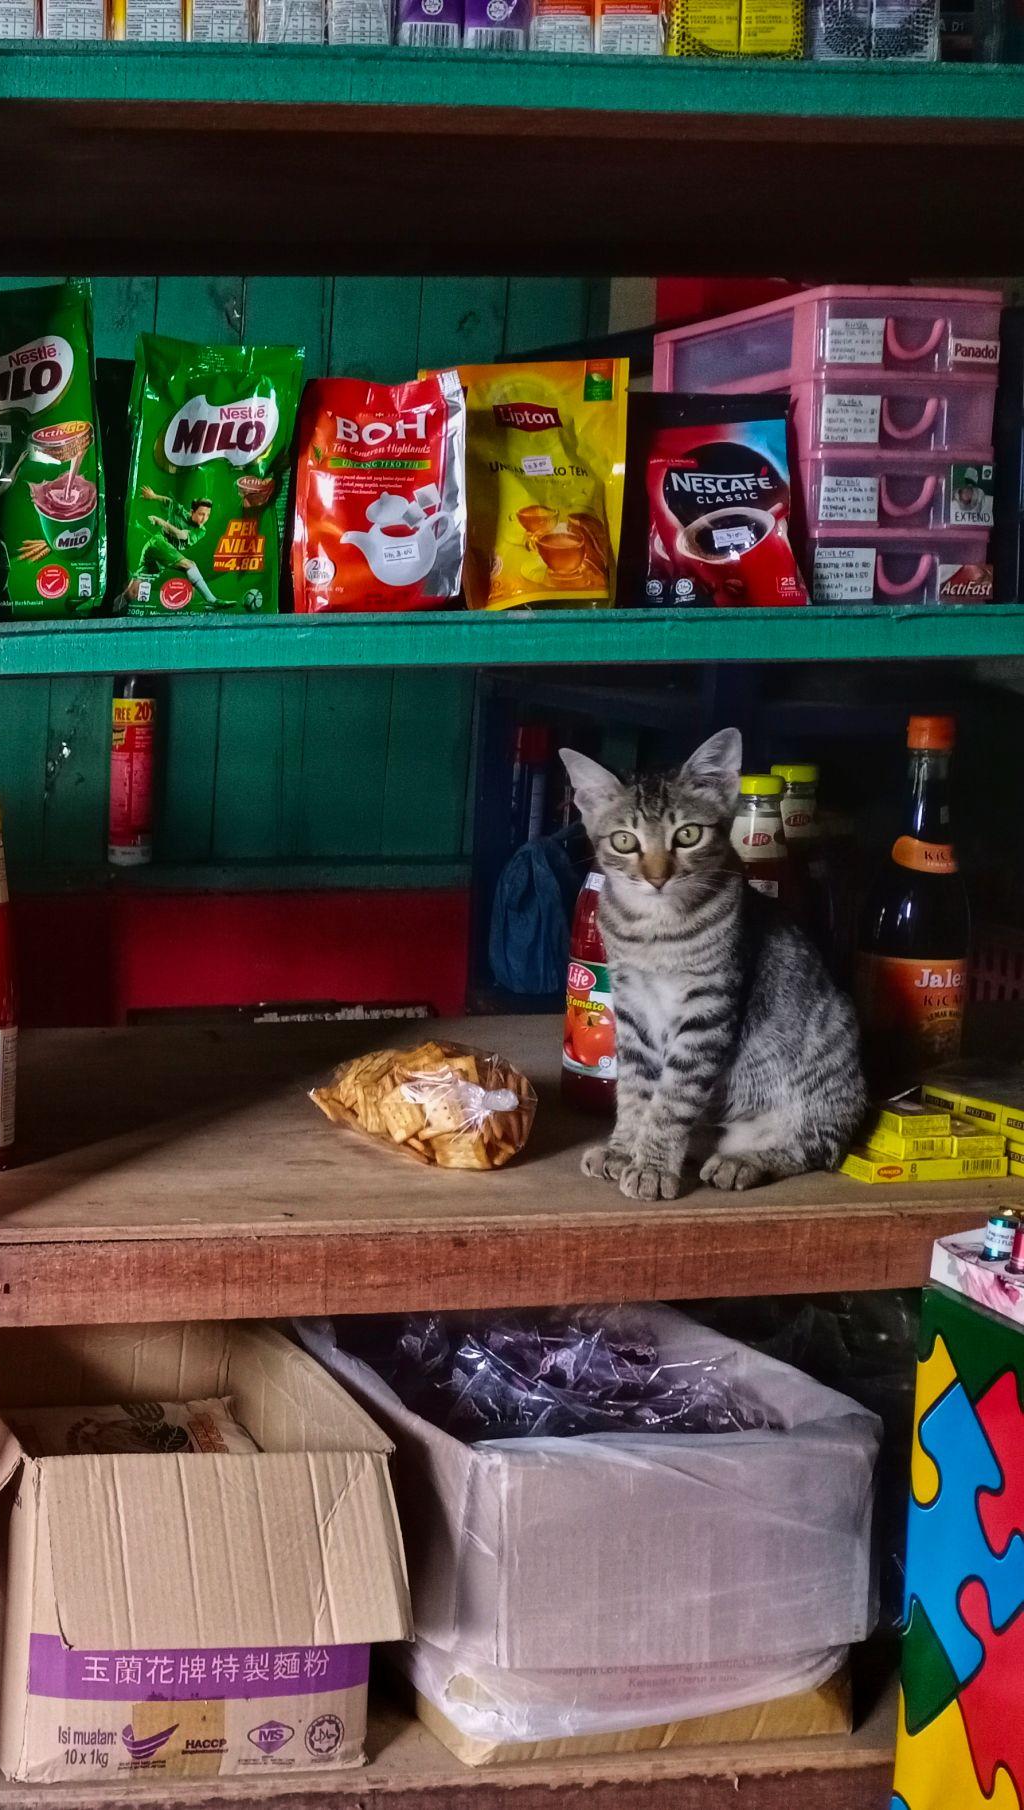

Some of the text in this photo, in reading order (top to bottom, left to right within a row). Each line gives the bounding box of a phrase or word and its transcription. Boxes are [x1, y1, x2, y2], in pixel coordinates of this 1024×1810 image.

[955, 343, 998, 359] Panadol
[499, 407, 555, 426] Lipton
[172, 418, 266, 455] MILO
[335, 412, 427, 446] BOH
[387, 442, 431, 456] Highlands
[696, 492, 759, 505] CLASSIC
[954, 512, 990, 523] EXTEND
[57, 534, 88, 548] MILO
[219, 537, 264, 554] NILAI
[781, 577, 796, 586] 25
[58, 1725, 117, 1746] Isi muatan:
[259, 1728, 284, 1742] MS
[185, 1738, 227, 1751] HACCP
[64, 1750, 79, 1765] 10
[89, 1748, 109, 1768] 1kg
